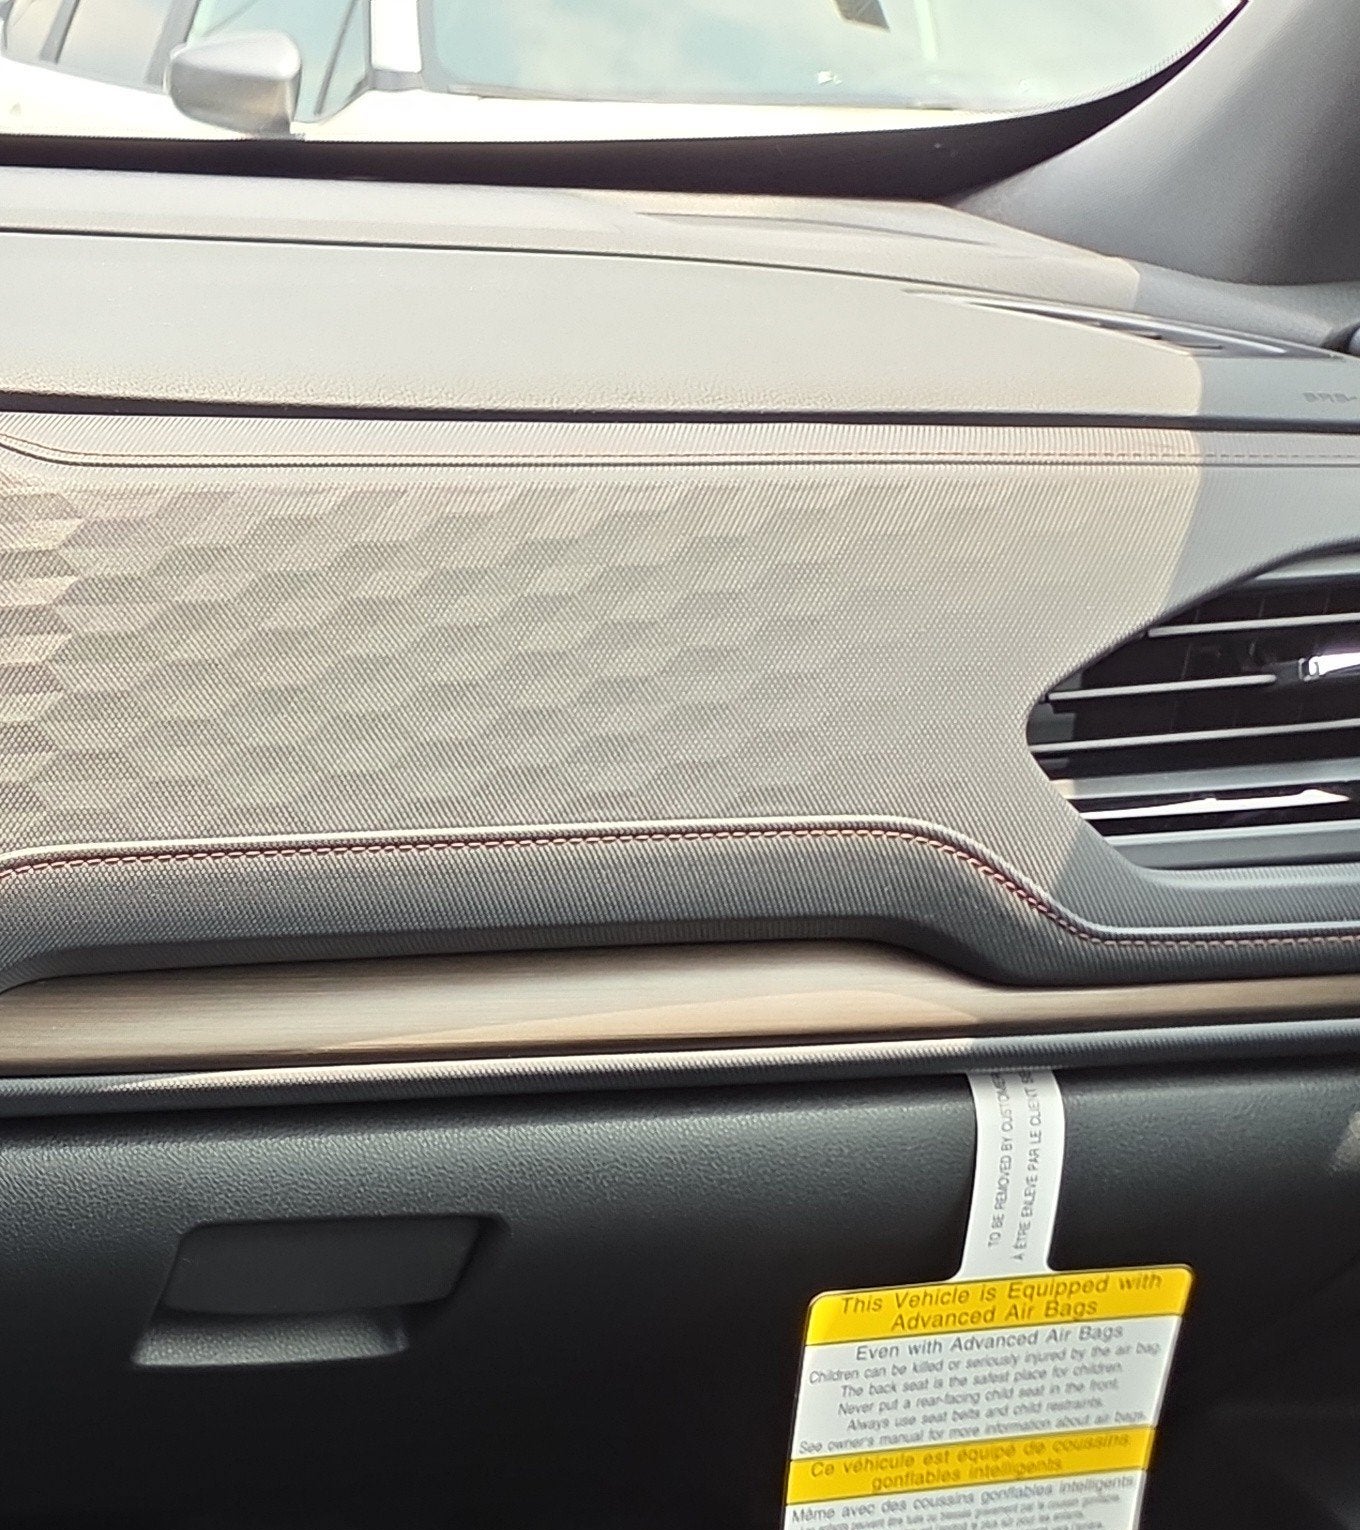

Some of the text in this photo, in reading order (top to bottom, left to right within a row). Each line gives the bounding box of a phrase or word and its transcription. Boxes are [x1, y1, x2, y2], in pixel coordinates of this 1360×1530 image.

[842, 1273, 1163, 1314] This Vehicle is Equipped with
[891, 1300, 1099, 1332] Advanced Air Bags
[856, 1325, 1124, 1361] Even with Advanced Air Bags
[809, 1368, 859, 1384] Children
[864, 1367, 886, 1380] can
[891, 1363, 907, 1376] be
[948, 1360, 961, 1371] or
[841, 1384, 864, 1398] The
[869, 1381, 897, 1396] back
[902, 1378, 929, 1392] seat
[948, 1375, 968, 1388] the
[837, 1402, 874, 1417] Never
[879, 1399, 898, 1414] put
[847, 1416, 889, 1432] Always
[799, 1440, 822, 1454] See
[811, 1461, 835, 1478] Ce
[923, 1450, 950, 1466] est
[1022, 1441, 1046, 1456] de
